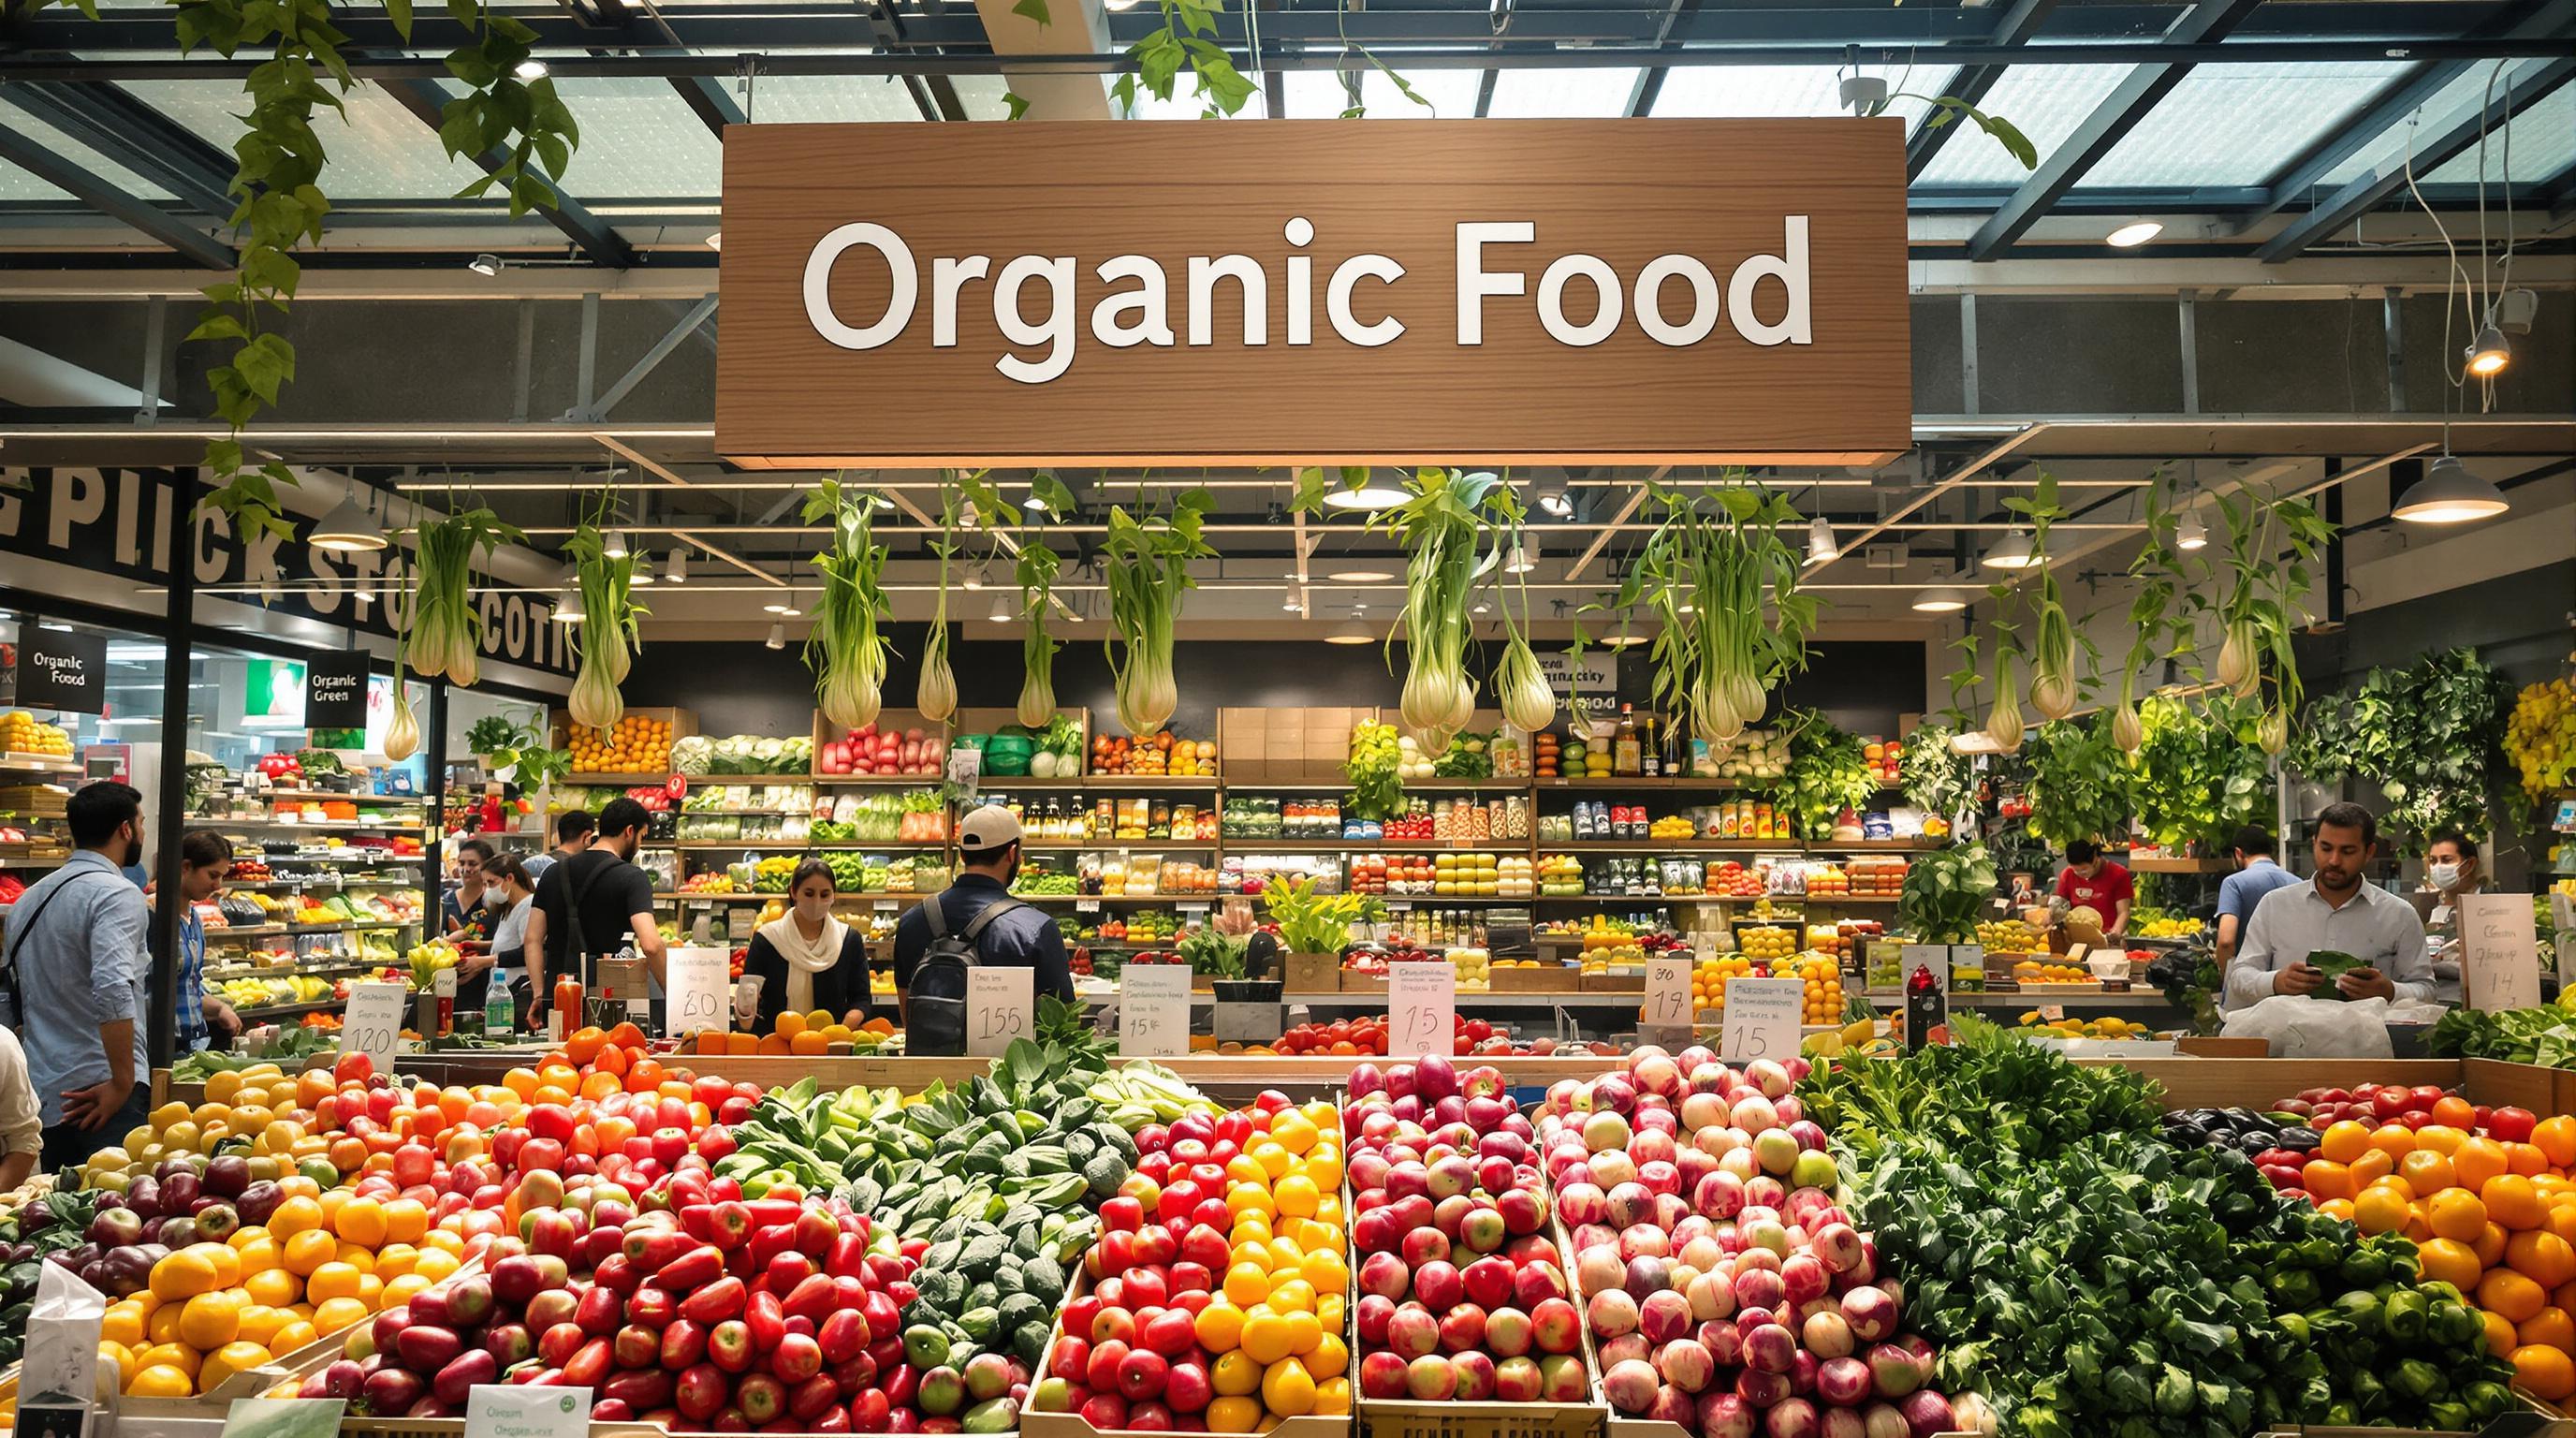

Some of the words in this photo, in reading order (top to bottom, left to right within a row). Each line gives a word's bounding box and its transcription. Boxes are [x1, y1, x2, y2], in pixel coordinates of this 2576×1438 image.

[801, 216, 1407, 385] Organic
[1456, 215, 1813, 347] Food
[34, 652, 83, 670] Organic
[313, 674, 357, 689] Organic
[315, 690, 349, 702] Green
[1405, 1005, 1439, 1046] 15
[351, 1027, 390, 1055] 120
[1734, 1025, 1767, 1059] 15
